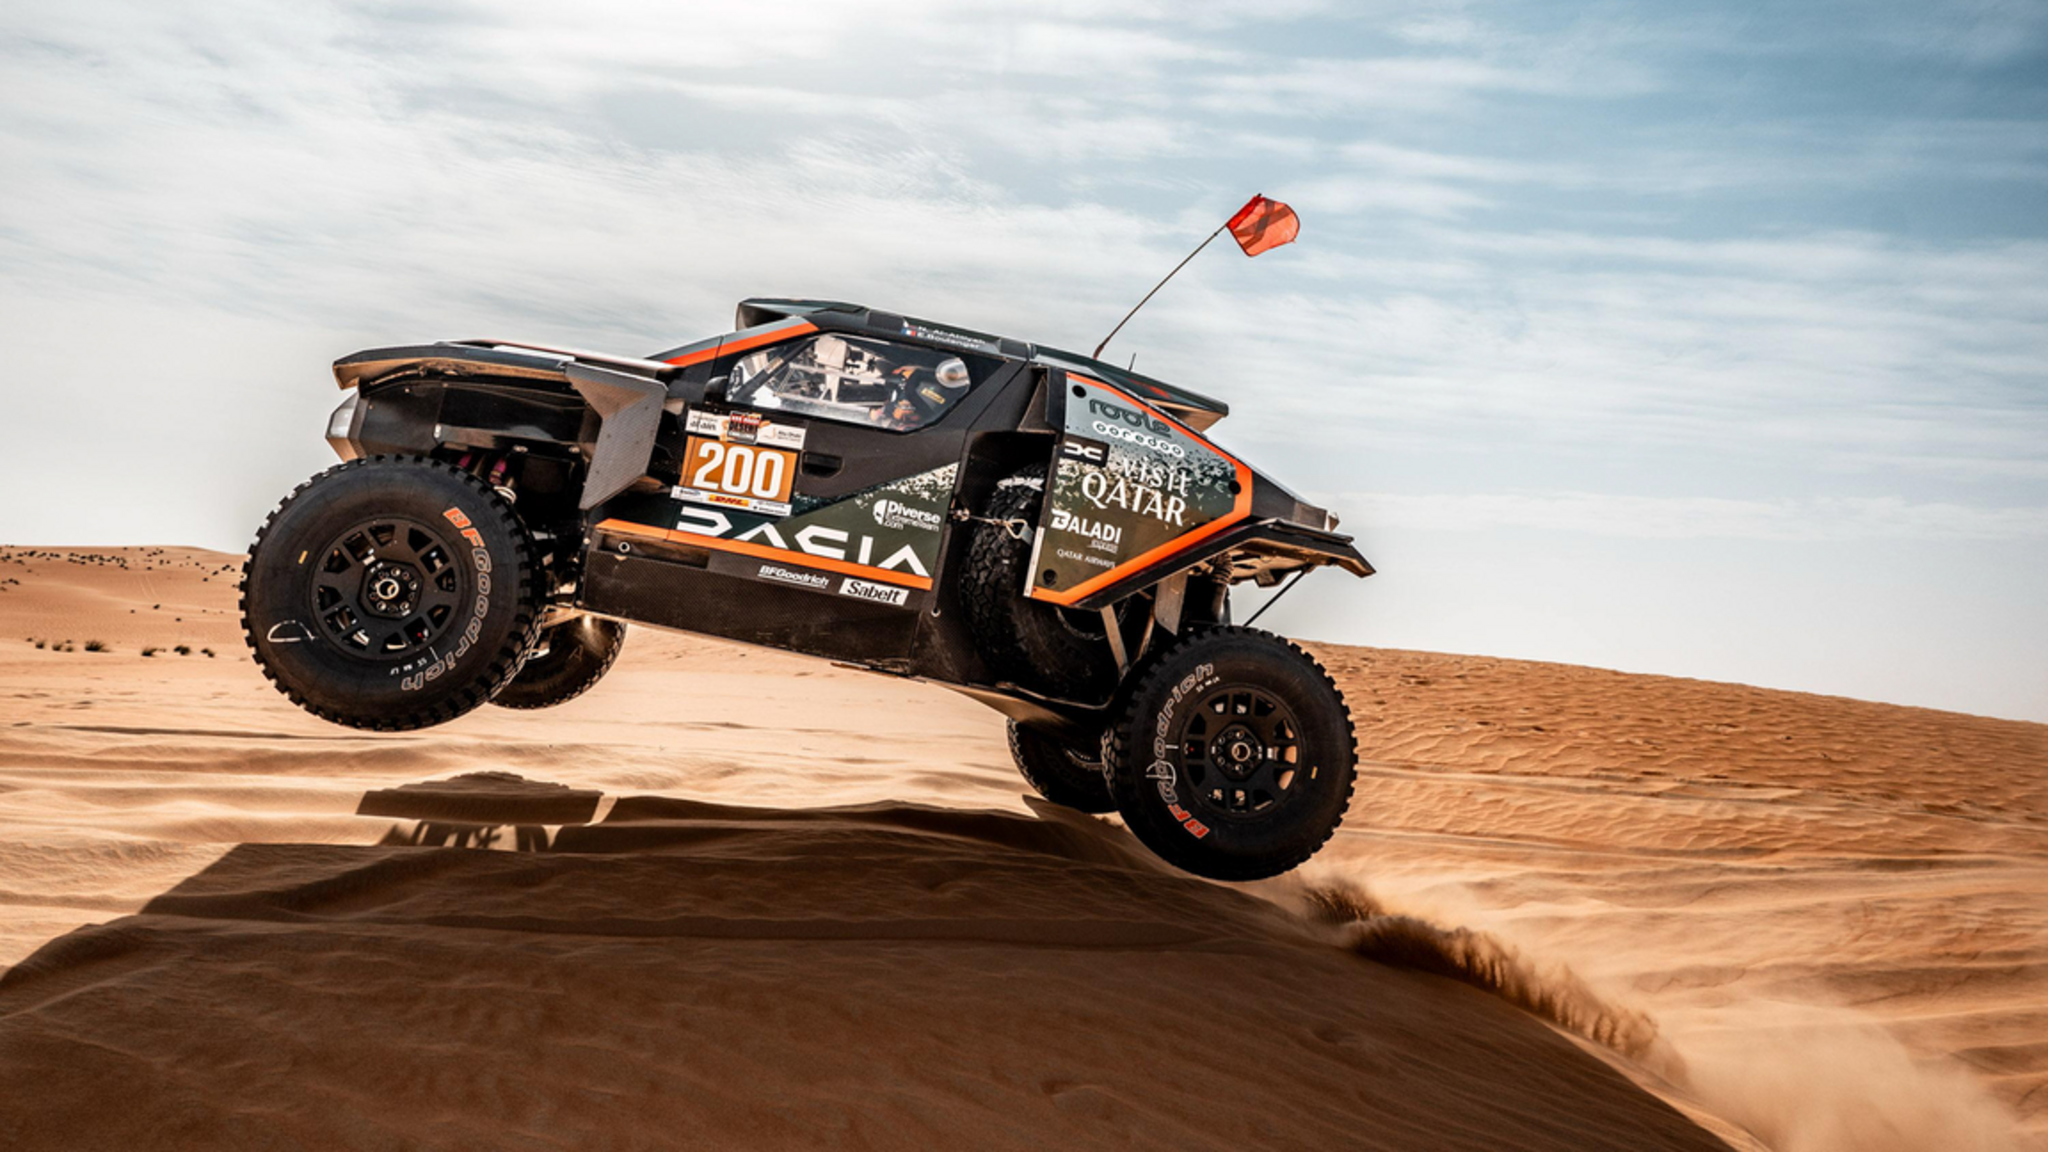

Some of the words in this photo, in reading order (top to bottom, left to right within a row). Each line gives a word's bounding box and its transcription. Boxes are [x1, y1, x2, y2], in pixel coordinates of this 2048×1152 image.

[1094, 421, 1183, 457] ooredoo
[692, 441, 785, 498] 200
[888, 500, 941, 524] Diverse
[1081, 472, 1187, 527] QATAR
[676, 506, 930, 577] DACIA
[1050, 508, 1122, 544] BALADI
[1056, 548, 1084, 563] QATAR
[758, 564, 830, 588] BFGoodrich
[847, 579, 902, 603] Sabelt
[401, 506, 492, 692] BFGoodrich
[1153, 662, 1215, 840] BFGoodrich
